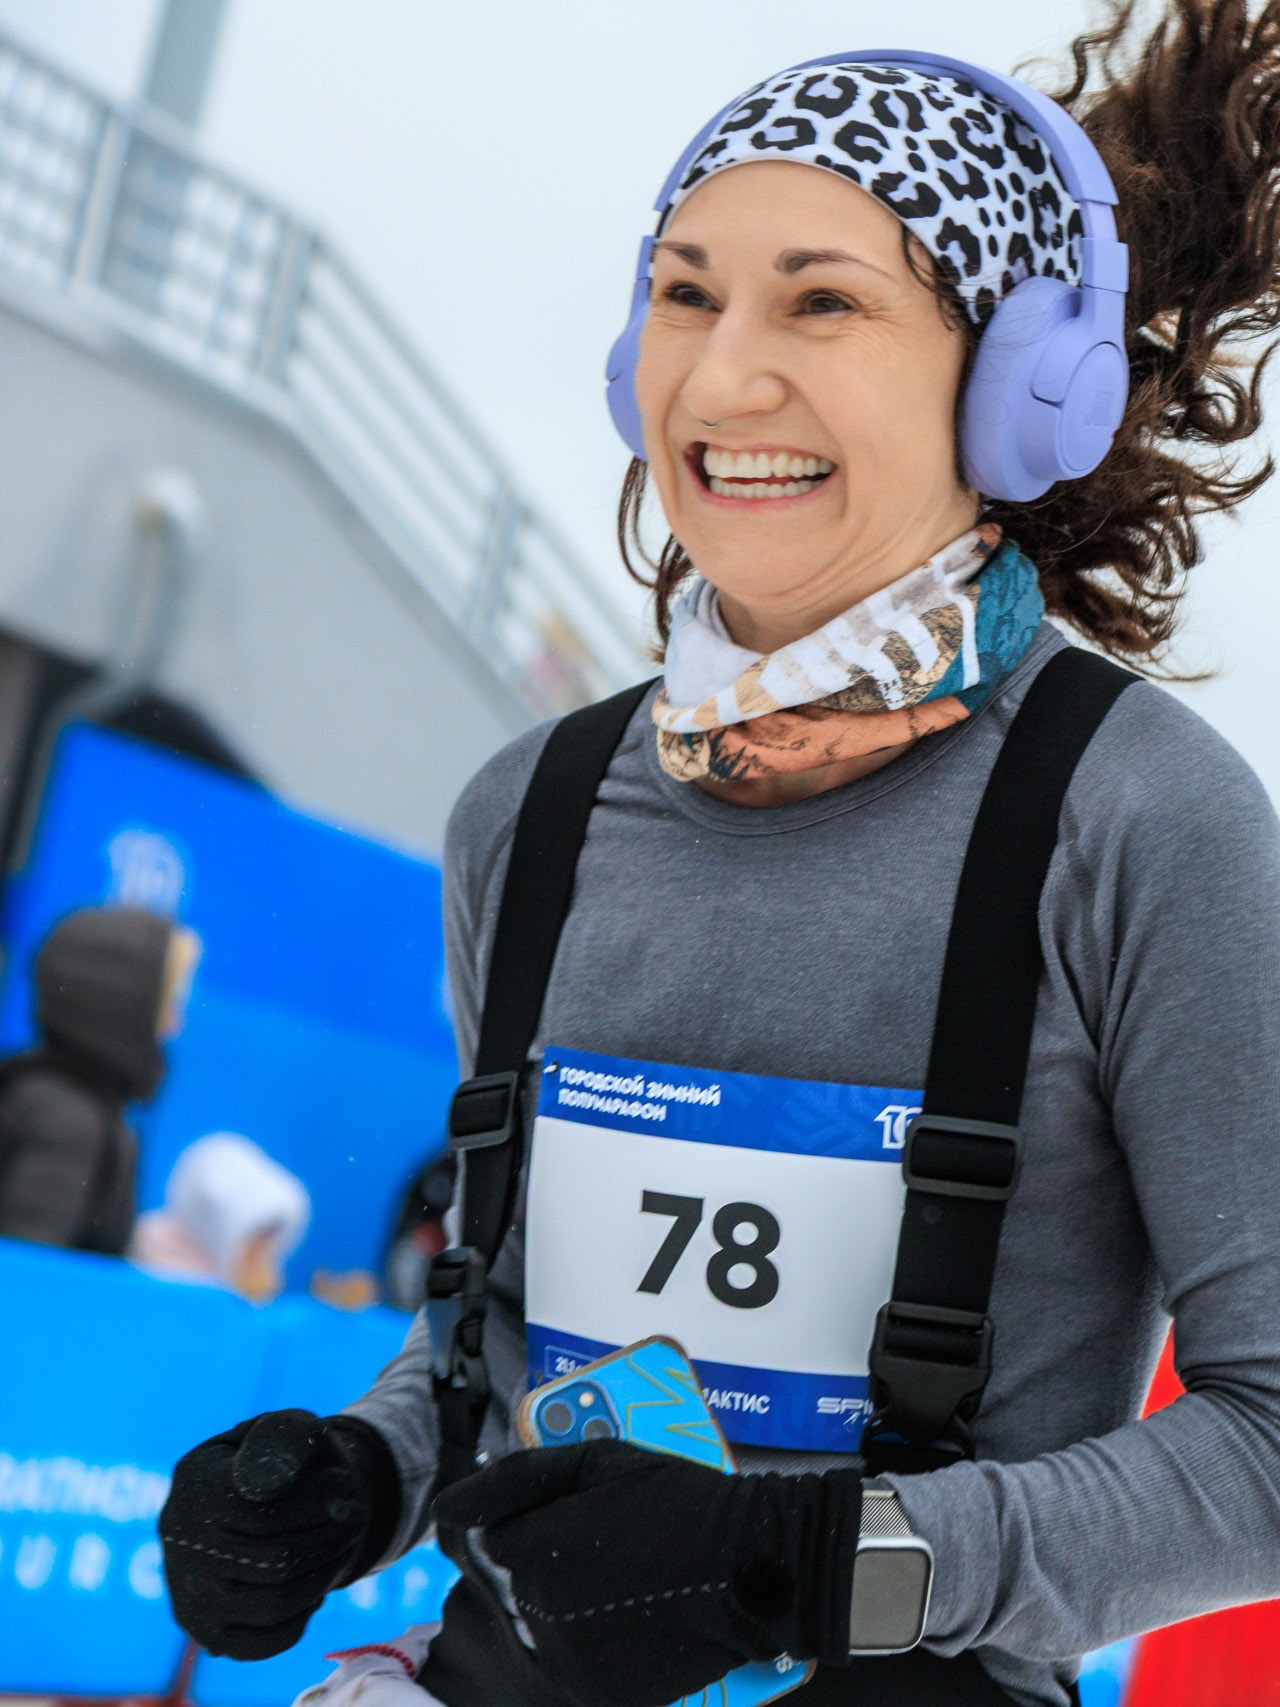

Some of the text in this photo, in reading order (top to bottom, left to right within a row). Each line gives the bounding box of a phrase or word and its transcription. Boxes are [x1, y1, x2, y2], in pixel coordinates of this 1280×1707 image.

[558, 1088, 667, 1122] ПОЛУМАРАФОН
[559, 1066, 721, 1106] ГОРОДСКОЙ ЗИМНИЙ
[636, 1189, 781, 1310] 78
